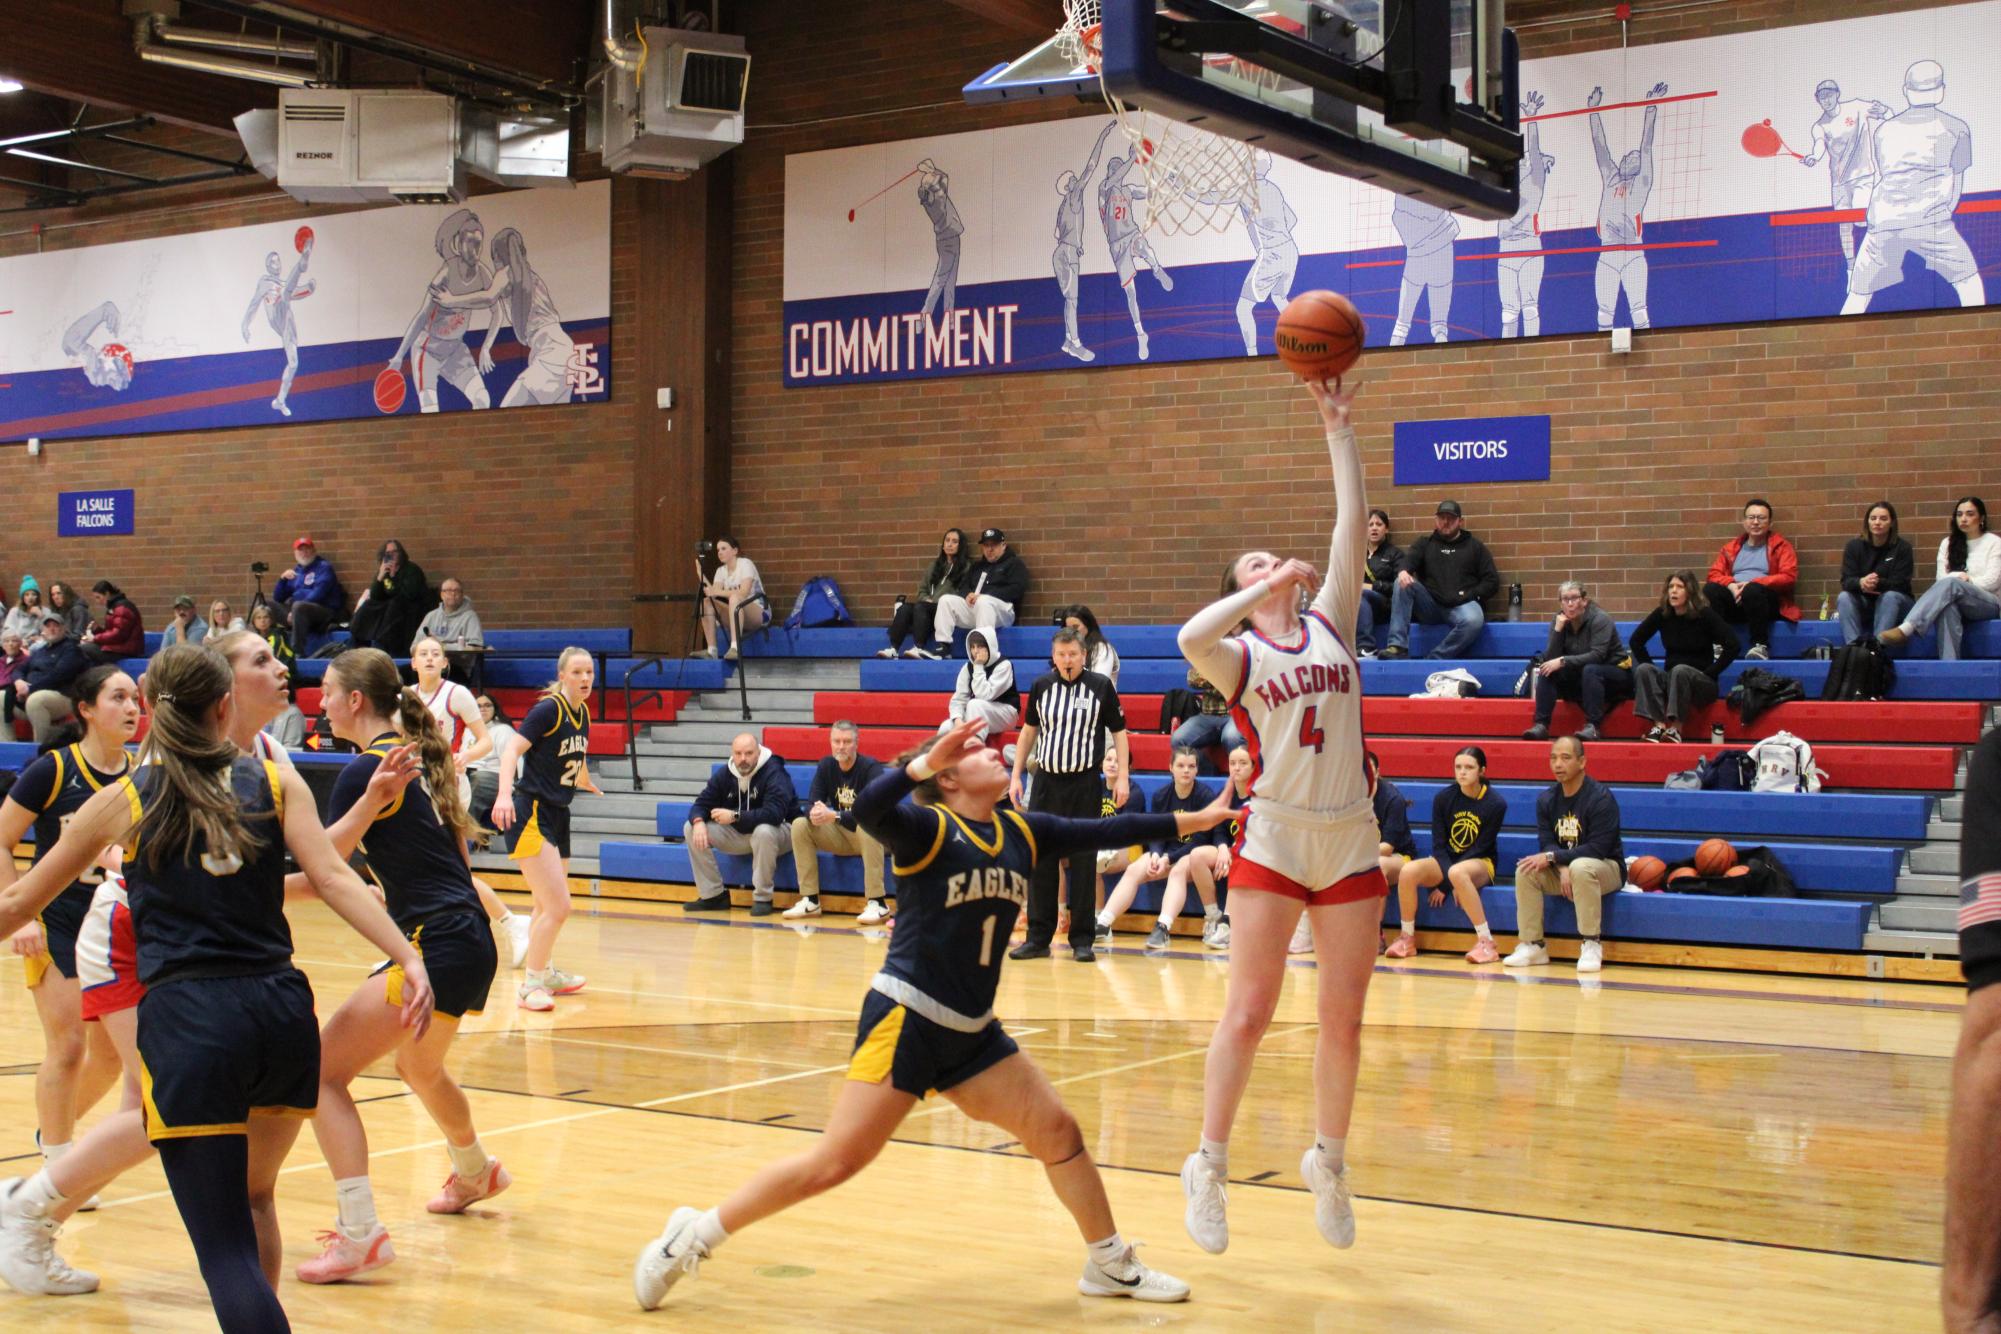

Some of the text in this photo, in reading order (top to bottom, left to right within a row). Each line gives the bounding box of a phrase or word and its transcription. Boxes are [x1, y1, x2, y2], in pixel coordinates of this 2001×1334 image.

[296, 152, 333, 160] REZNOR
[790, 304, 1018, 379] COMMITMENT
[1433, 440, 1508, 461] VISITORS
[76, 498, 115, 512] LA SALLE
[76, 514, 115, 528] FALCONS
[1254, 663, 1350, 712] FALCONS
[1299, 705, 1325, 755] 4
[944, 866, 1028, 909] EAGLE
[979, 915, 997, 967] 1
